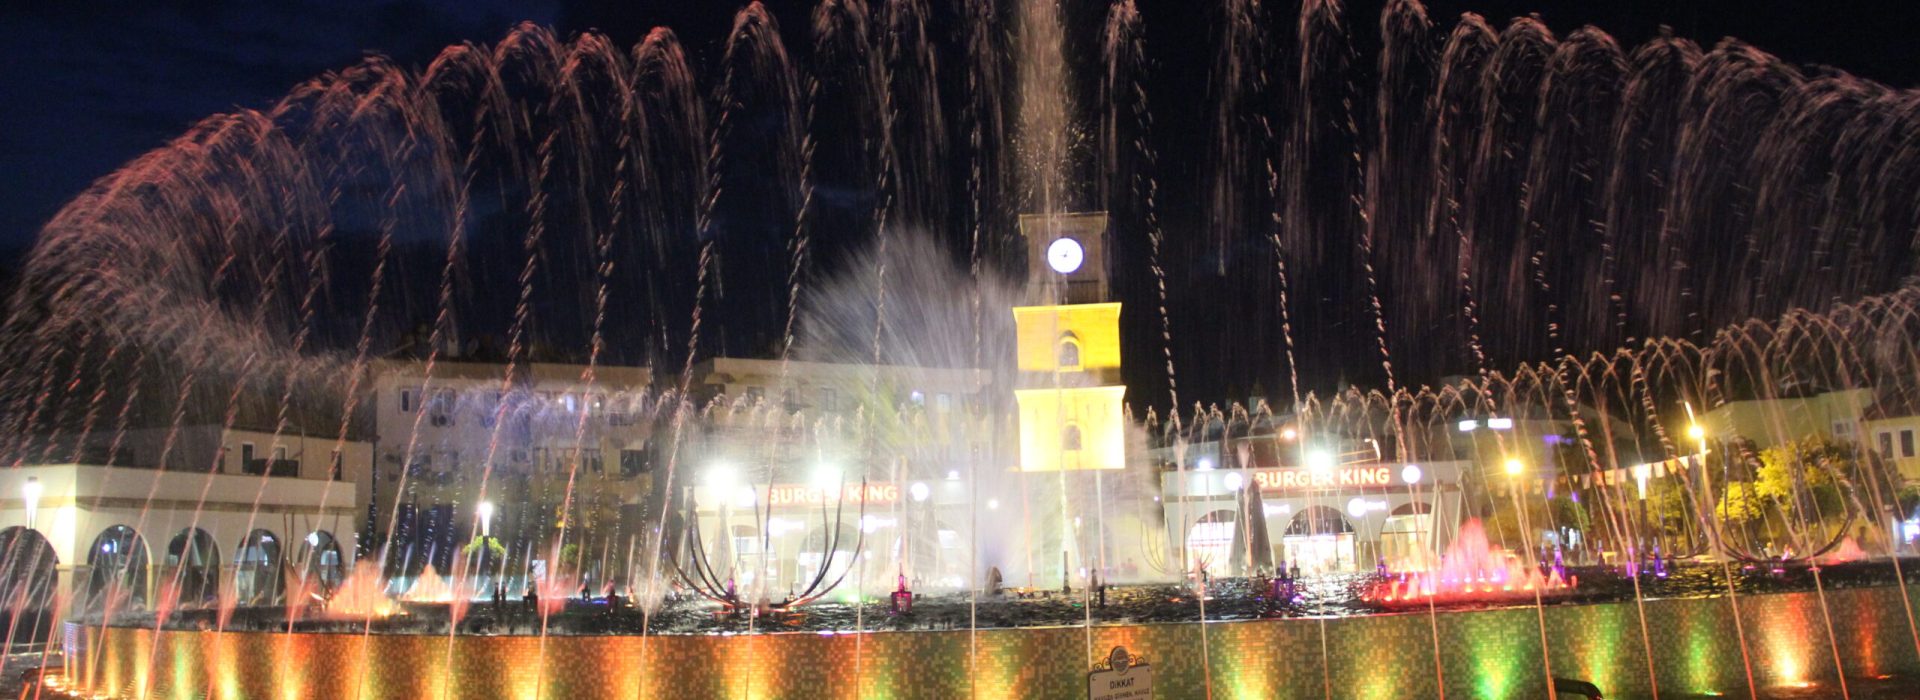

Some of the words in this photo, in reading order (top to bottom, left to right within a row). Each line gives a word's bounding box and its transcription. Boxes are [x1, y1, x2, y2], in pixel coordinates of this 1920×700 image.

[1256, 471, 1335, 488] BURGER
[1339, 467, 1390, 485] KING
[769, 487, 840, 504] BURG
[847, 485, 898, 502] KING
